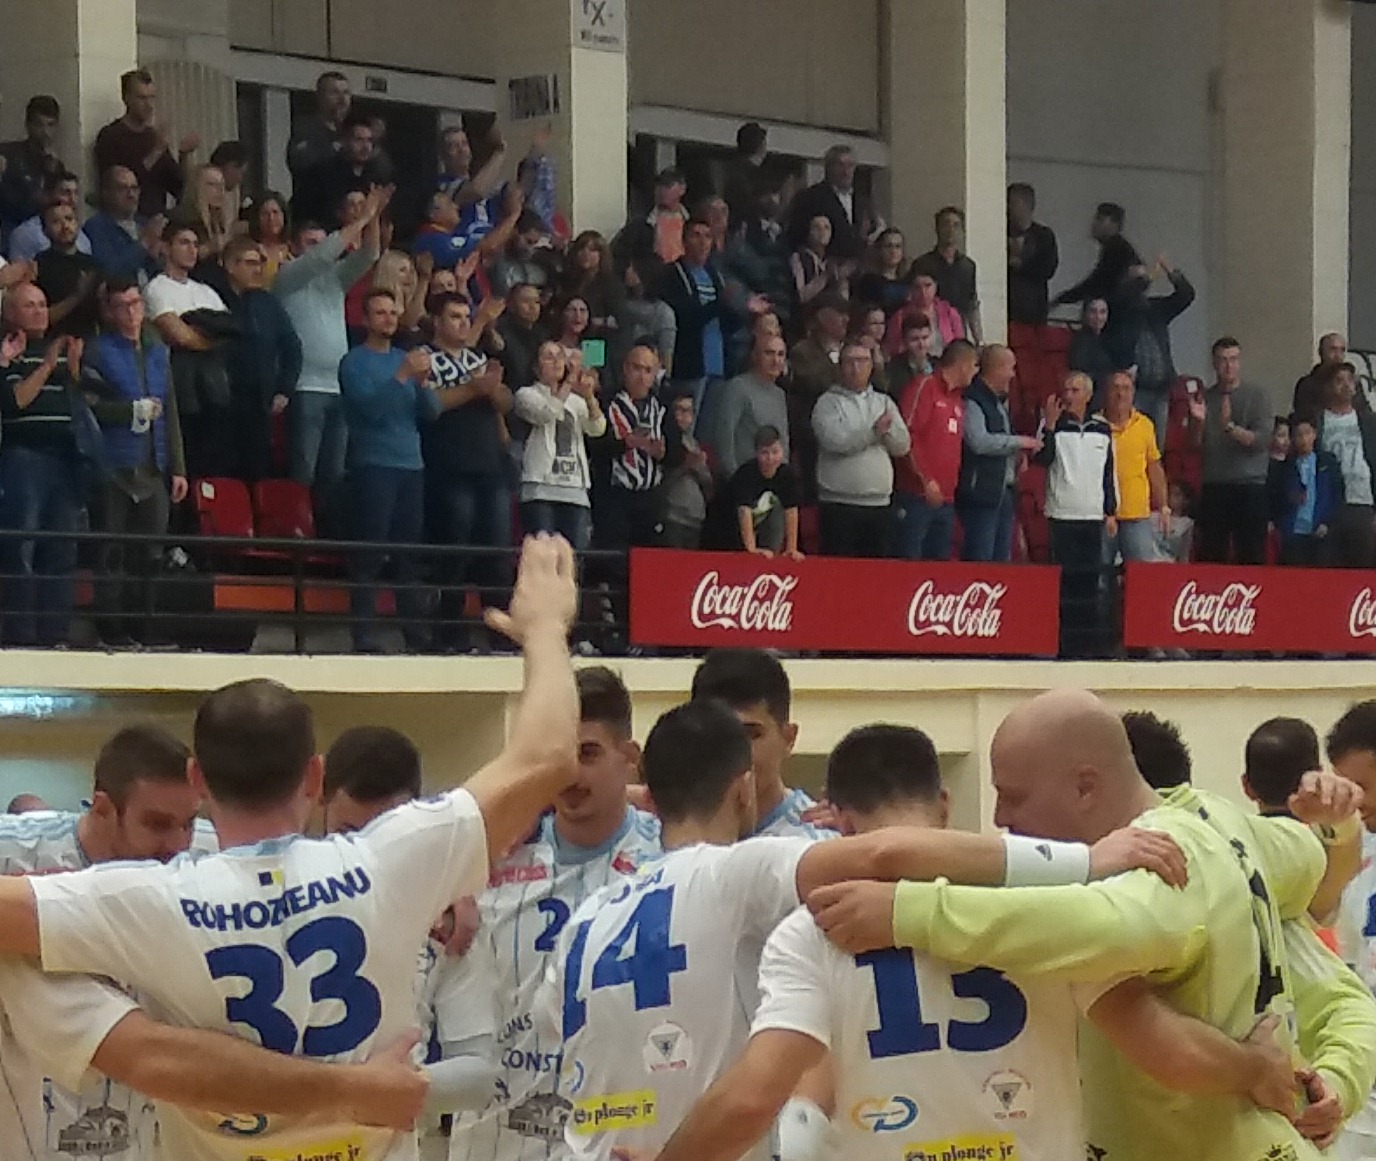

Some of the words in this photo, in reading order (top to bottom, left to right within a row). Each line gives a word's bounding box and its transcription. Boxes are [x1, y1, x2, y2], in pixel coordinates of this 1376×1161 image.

[691, 571, 798, 631] Coca-Cola
[907, 580, 1006, 637] Coca-Cola
[1173, 580, 1262, 635] Coca-Cola
[205, 916, 381, 1056] 33
[563, 884, 687, 1042] 14
